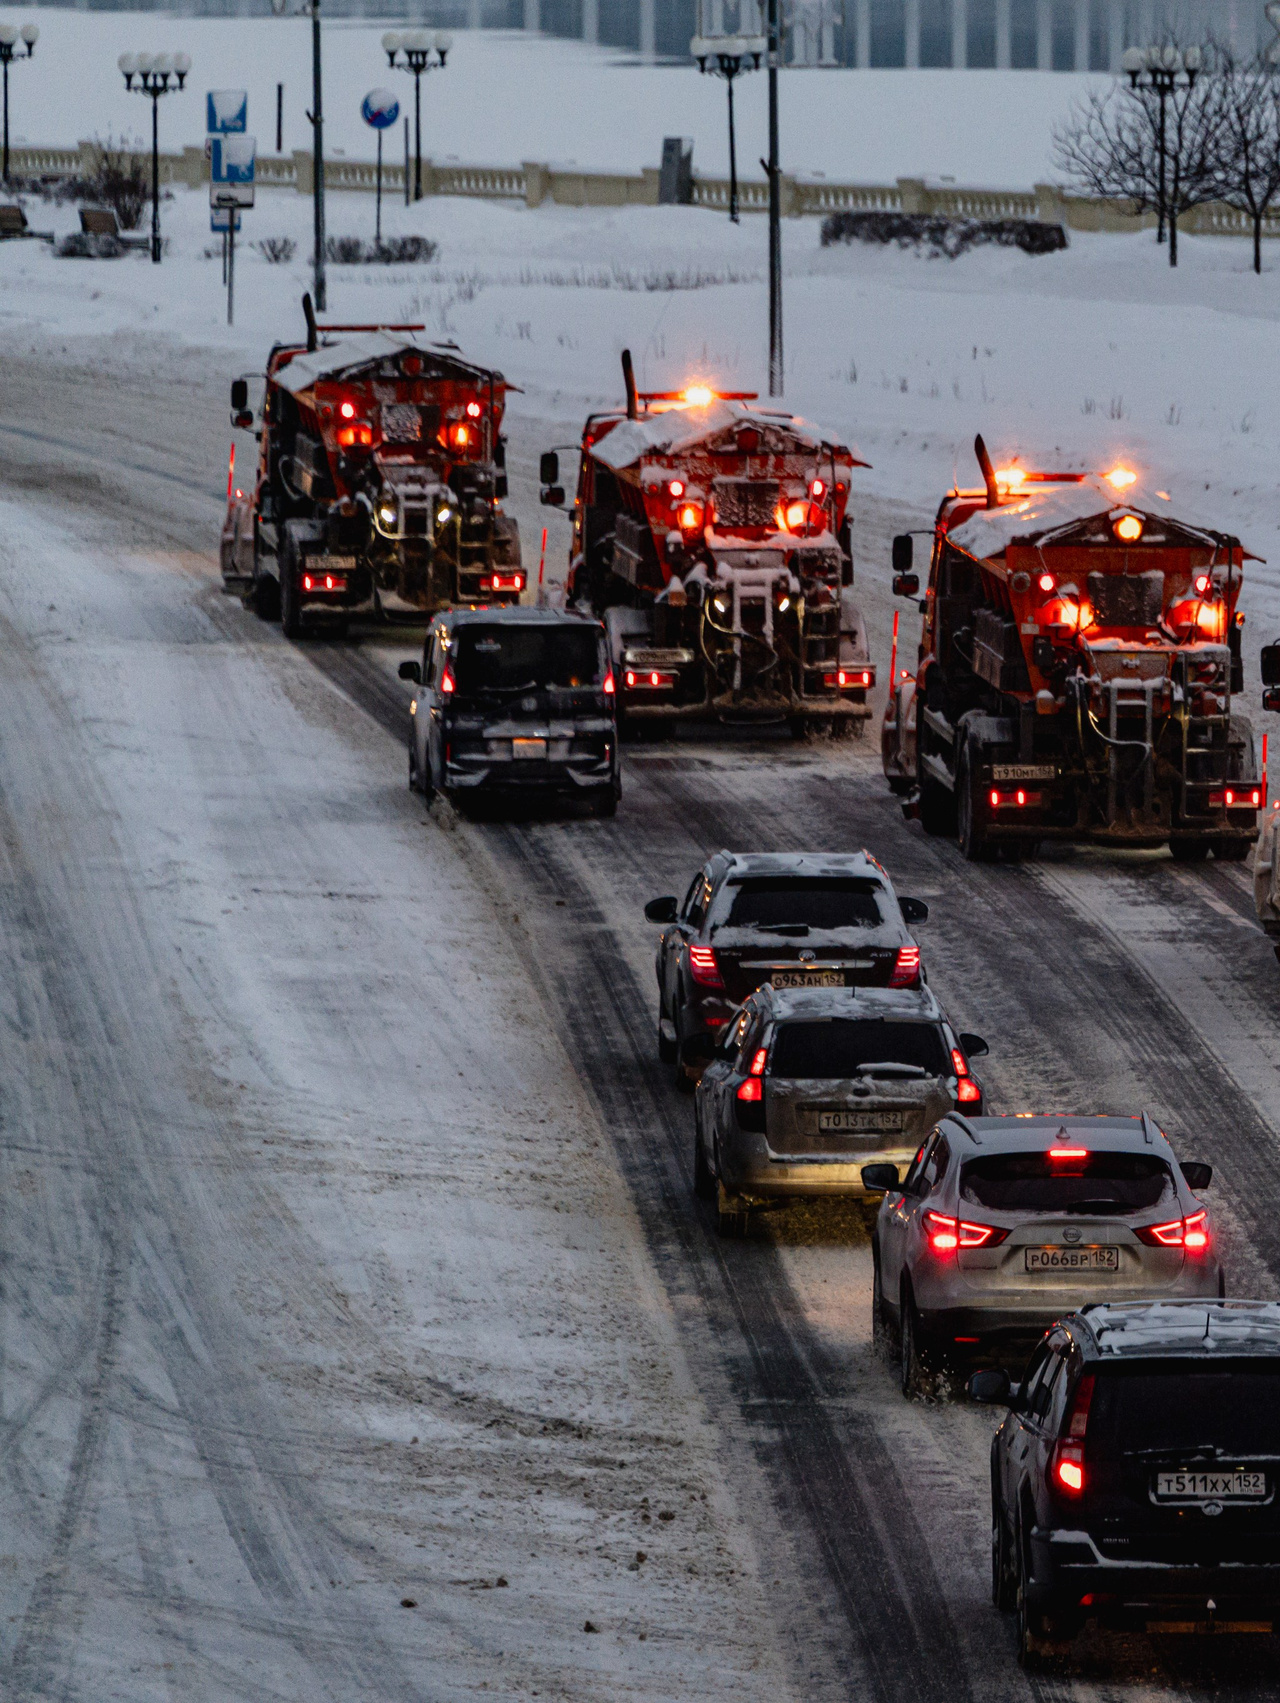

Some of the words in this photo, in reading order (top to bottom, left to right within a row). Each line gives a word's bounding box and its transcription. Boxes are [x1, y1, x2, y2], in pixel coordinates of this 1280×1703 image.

[1031, 1251, 1089, 1266] Р066ВР
[1091, 1250, 1114, 1262] 152
[1164, 1475, 1232, 1493] Т511ХХ
[1235, 1474, 1260, 1488] 152
